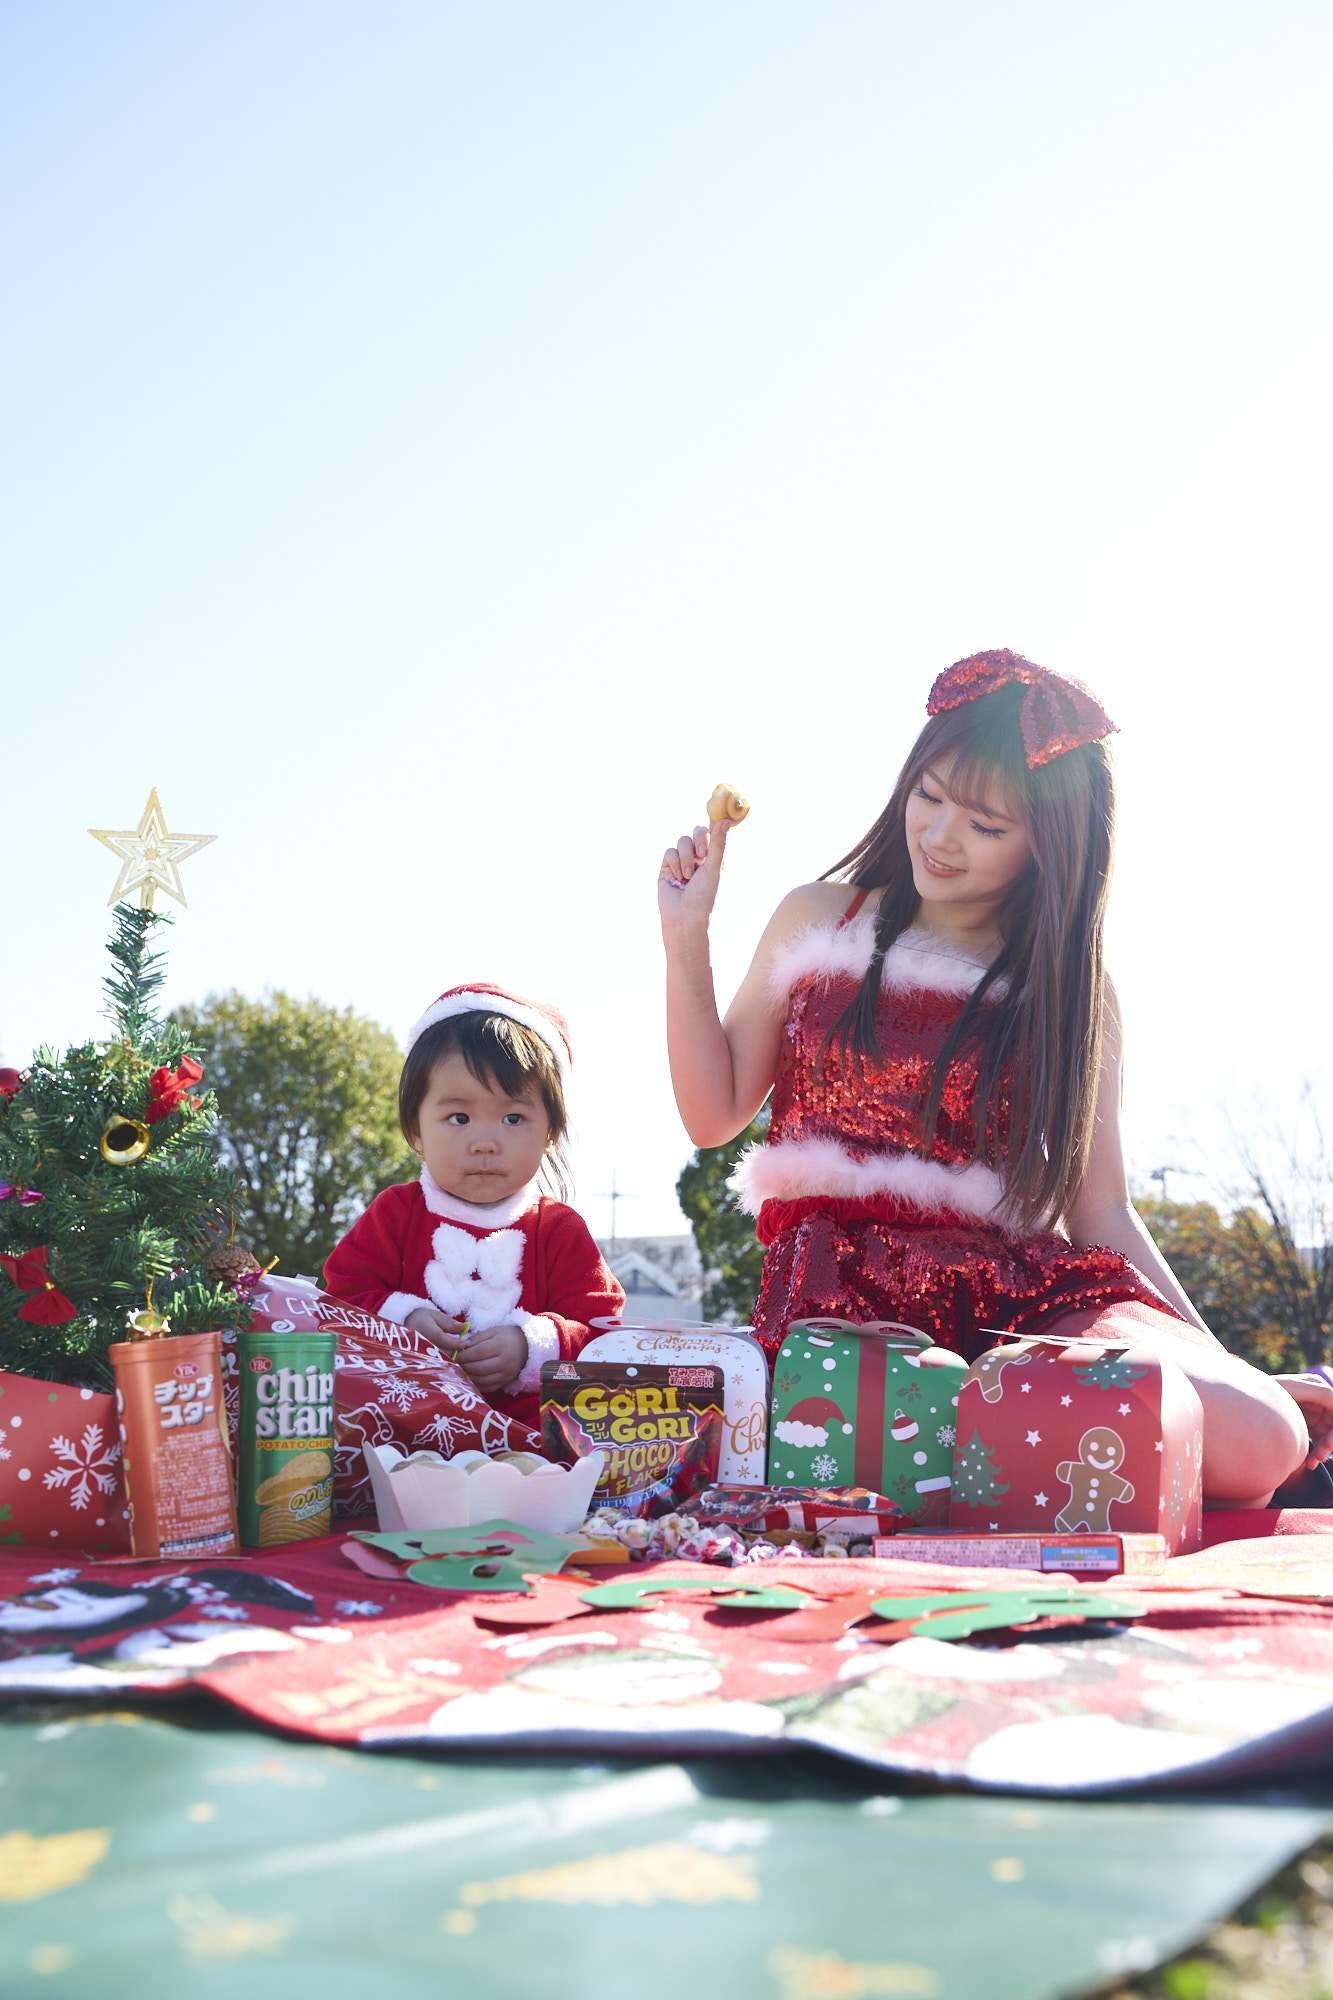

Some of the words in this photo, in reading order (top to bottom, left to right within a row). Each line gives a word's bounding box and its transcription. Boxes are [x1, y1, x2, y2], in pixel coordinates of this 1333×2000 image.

[285, 1295, 413, 1351] CHRISTMAS
[154, 1373, 214, 1405] チップ
[256, 1365, 334, 1404] chip
[160, 1401, 215, 1429] スター
[255, 1401, 334, 1437] star
[256, 1440, 306, 1449] POTATO
[615, 1467, 661, 1494] FLAKE
